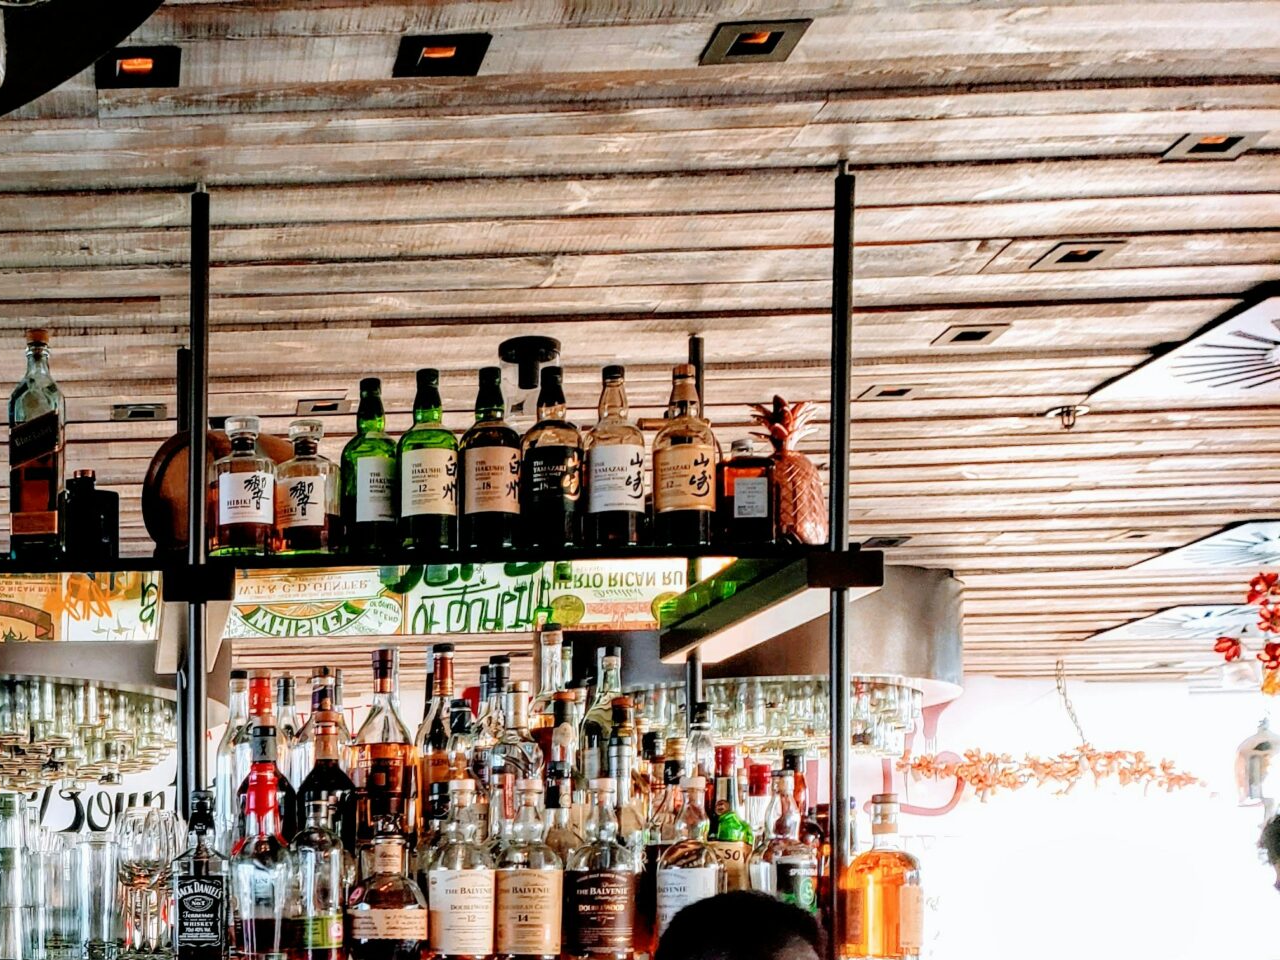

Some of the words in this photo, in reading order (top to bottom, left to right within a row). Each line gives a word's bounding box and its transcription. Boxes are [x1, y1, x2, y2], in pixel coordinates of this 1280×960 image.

[418, 484, 428, 493] 12
[481, 481, 492, 490] 18
[511, 886, 551, 895] BALVENIE
[589, 886, 629, 896] BALVENIE
[466, 914, 476, 922] 12
[517, 914, 529, 922] 14
